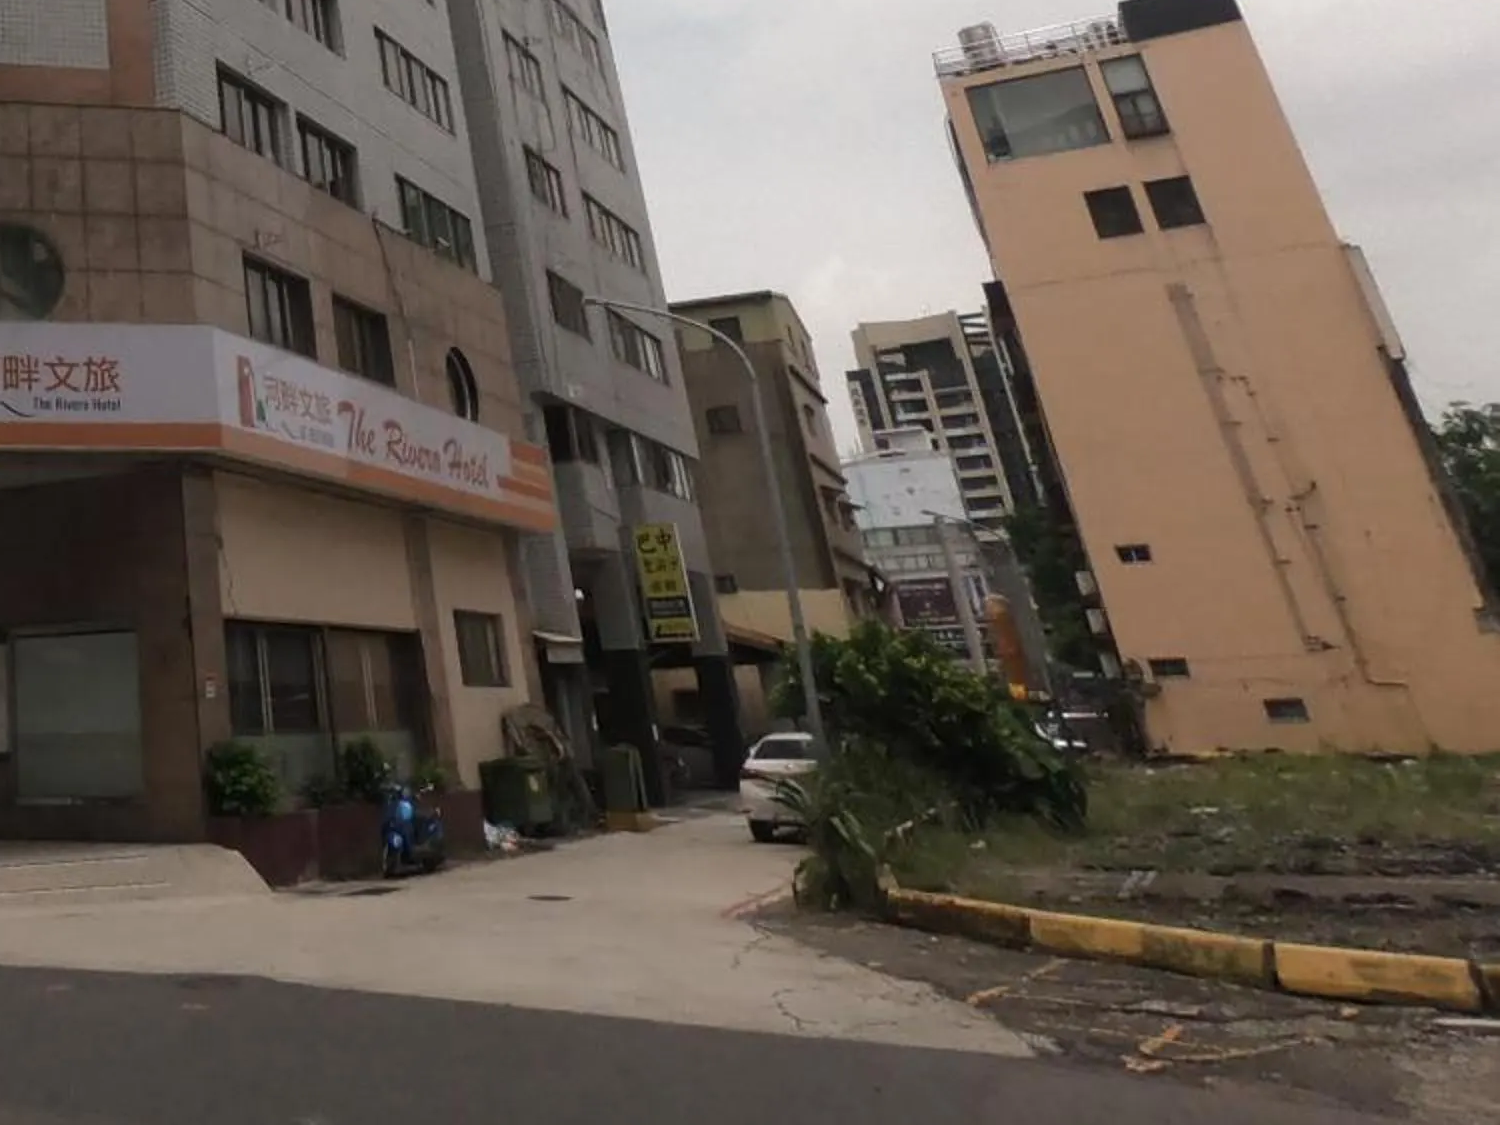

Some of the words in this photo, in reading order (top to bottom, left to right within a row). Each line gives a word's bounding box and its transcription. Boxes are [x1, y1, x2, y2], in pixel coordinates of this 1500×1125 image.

[33, 396, 51, 411] The
[92, 398, 121, 412] Hotel
[337, 400, 375, 456] The
[443, 438, 490, 488] Hotel
